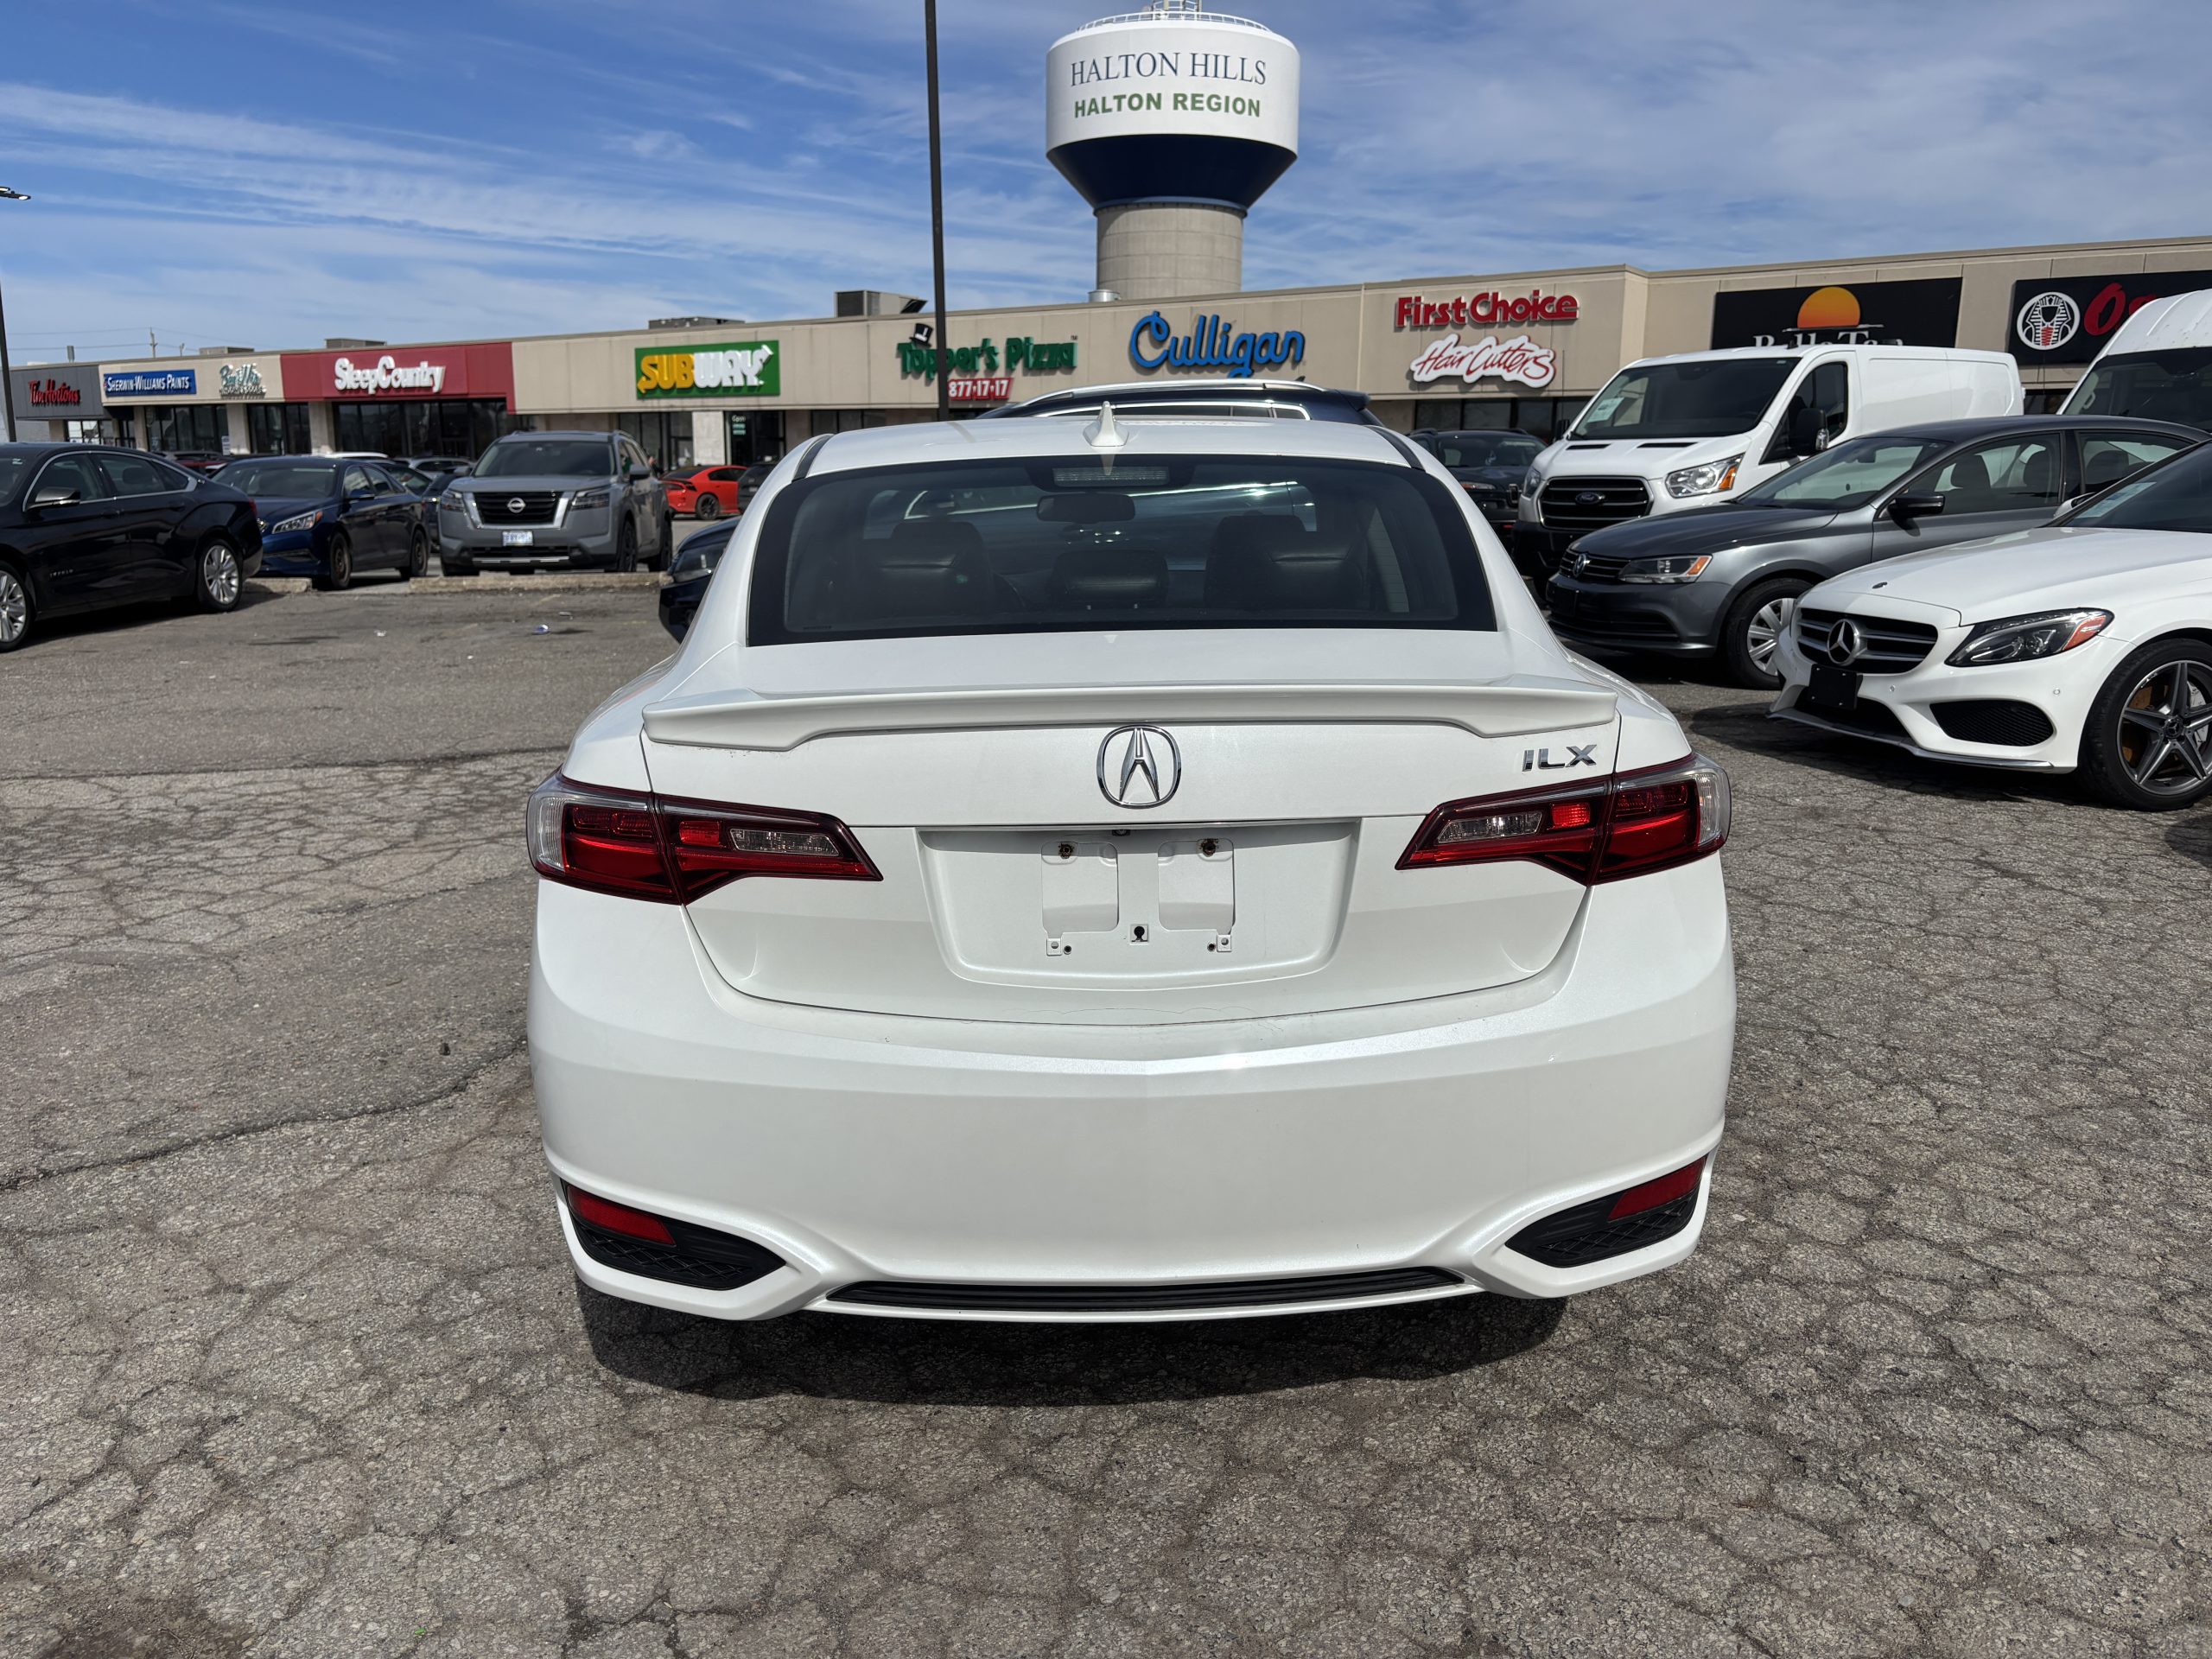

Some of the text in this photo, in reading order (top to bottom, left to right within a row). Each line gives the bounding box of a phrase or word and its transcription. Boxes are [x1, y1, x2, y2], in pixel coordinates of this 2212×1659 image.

[1071, 52, 1267, 86] HALTON HILLS
[1074, 92, 1261, 118] HALTON REGION
[1396, 289, 1579, 327] First Choice
[1006, 337, 1077, 370] Pizza
[1130, 310, 1306, 378] Culligan
[1415, 341, 1552, 379] Hair Cutters
[167, 373, 190, 390] PAINTS
[334, 355, 445, 394] SleepCountry
[637, 344, 773, 393] SUBWAY
[29, 378, 80, 404] Tim Hortons
[1522, 744, 1598, 772] ILX
